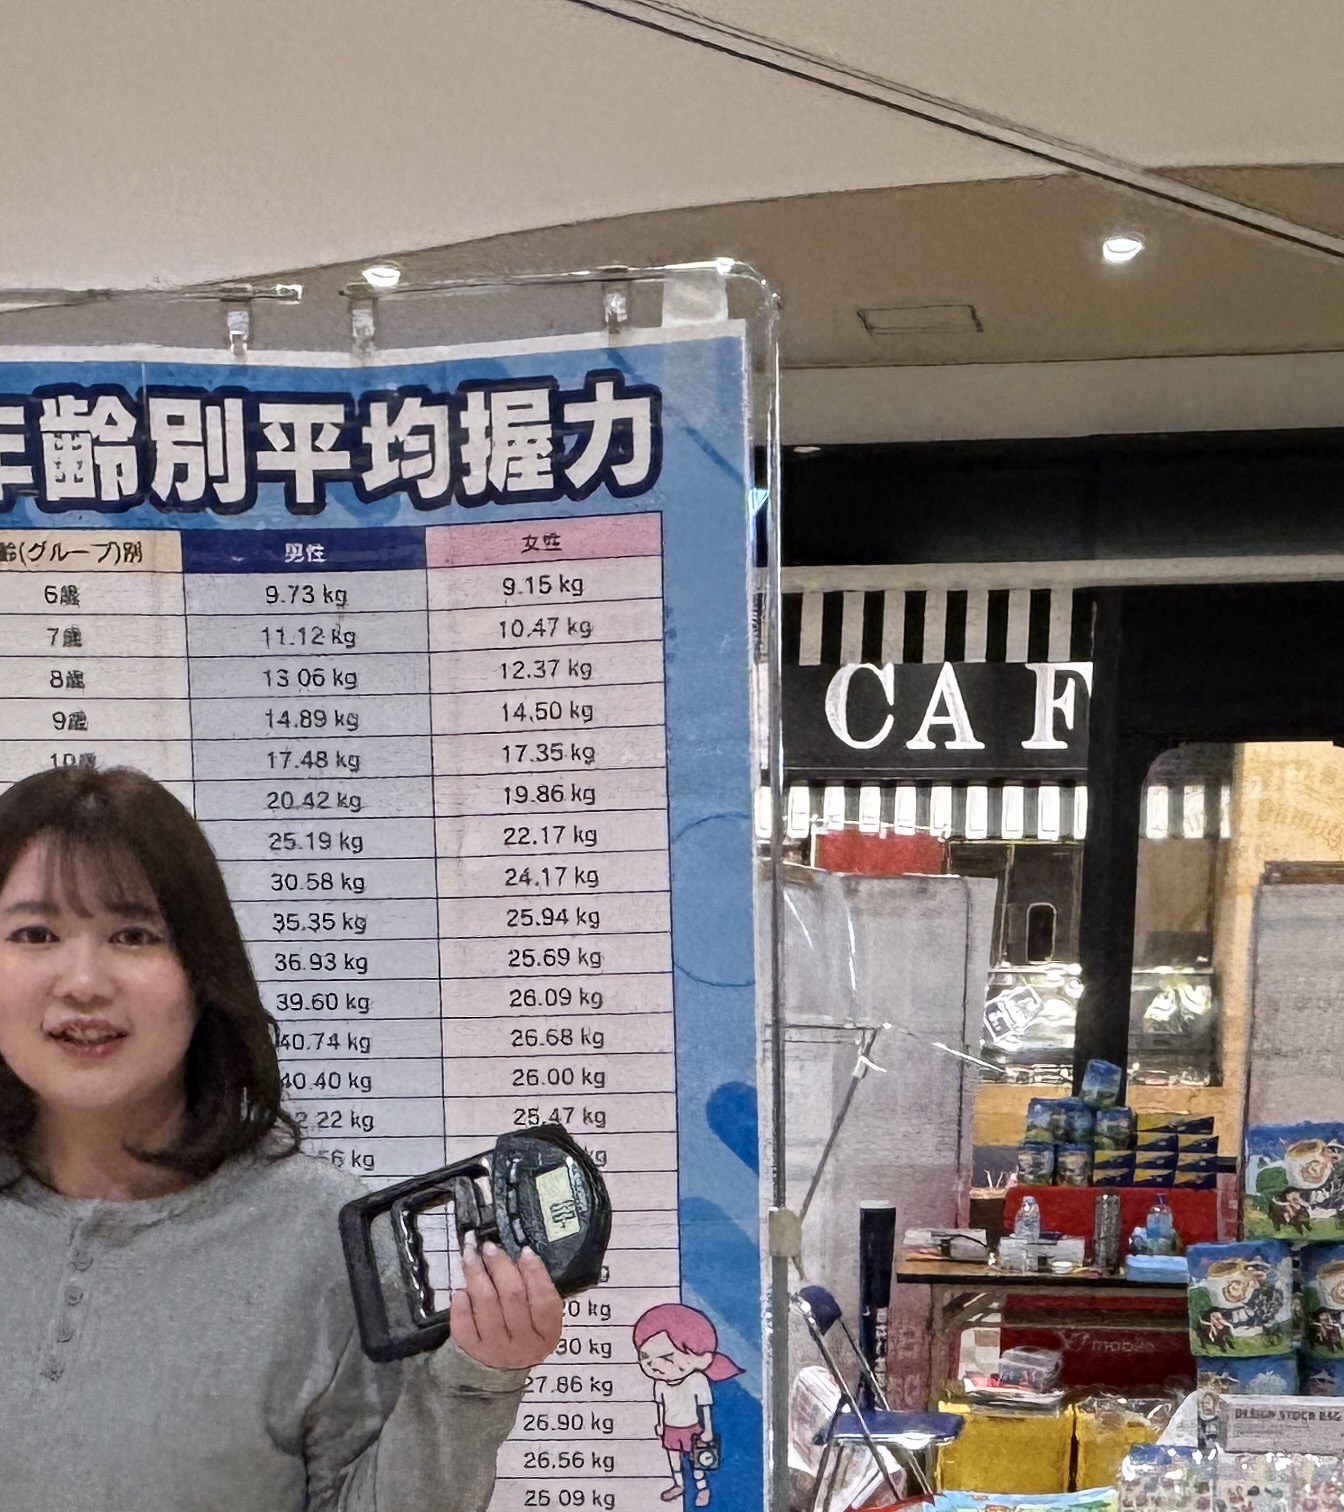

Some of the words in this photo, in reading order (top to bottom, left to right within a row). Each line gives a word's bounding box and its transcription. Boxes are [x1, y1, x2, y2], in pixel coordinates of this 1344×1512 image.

[284, 542, 327, 563] 男性
[521, 532, 563, 554] 女性
[265, 585, 315, 604] 9.73
[323, 585, 347, 606] kg
[503, 576, 552, 596] 9.15
[559, 575, 584, 596] kg
[262, 626, 324, 646] 11.12
[331, 626, 356, 648] kg
[500, 617, 559, 639] 10.47
[567, 617, 593, 639] kg
[333, 668, 357, 689] kg
[500, 660, 560, 680] 12.37
[568, 659, 592, 680] kg
[265, 709, 327, 729] 14.89
[335, 710, 359, 731] kg
[502, 701, 562, 723] 14.50
[569, 700, 593, 723] kg
[267, 750, 328, 769] 17.48
[336, 750, 360, 772] kg
[502, 743, 563, 763] 17.35
[571, 743, 595, 765] kg
[267, 791, 330, 810] 20.42
[338, 791, 362, 813] kg
[504, 784, 564, 805] 19.86
[571, 784, 596, 805] kg
[268, 832, 331, 851] 25.19
[340, 831, 363, 853] kg
[503, 826, 566, 846] 22.17
[573, 825, 597, 847] kg
[271, 873, 333, 891] 30.58
[341, 872, 365, 893] kg
[505, 867, 567, 887] 24.17
[575, 867, 599, 887] kg
[272, 913, 335, 933] 35.35
[343, 912, 366, 934] kg
[507, 907, 569, 927] 25.94
[576, 907, 600, 929] kg
[274, 953, 337, 971] 36.93
[345, 953, 368, 974] kg
[508, 948, 570, 968] 25.69
[579, 948, 602, 969] kg
[276, 993, 338, 1011] 39.60
[347, 993, 370, 1014] kg
[509, 988, 572, 1007] 26.09
[580, 987, 604, 1009] kg
[348, 1033, 371, 1053] kg
[511, 1028, 573, 1047] 26.68
[581, 1026, 605, 1049] kg
[348, 1072, 372, 1092] kg
[512, 1068, 574, 1087] 26.00
[582, 1067, 606, 1089] kg
[296, 1110, 343, 1129] 2.22
[350, 1109, 374, 1132] kg
[513, 1107, 574, 1126] 25.47
[583, 1107, 606, 1129] kg
[352, 1149, 375, 1171] kg
[588, 1300, 612, 1321] kg
[589, 1338, 612, 1359] kg
[591, 1376, 613, 1396] kg
[523, 1414, 584, 1432] 26.90
[591, 1413, 614, 1434] kg
[524, 1452, 585, 1470] 26.56
[592, 1452, 615, 1472] kg
[592, 1489, 615, 1510] kg
